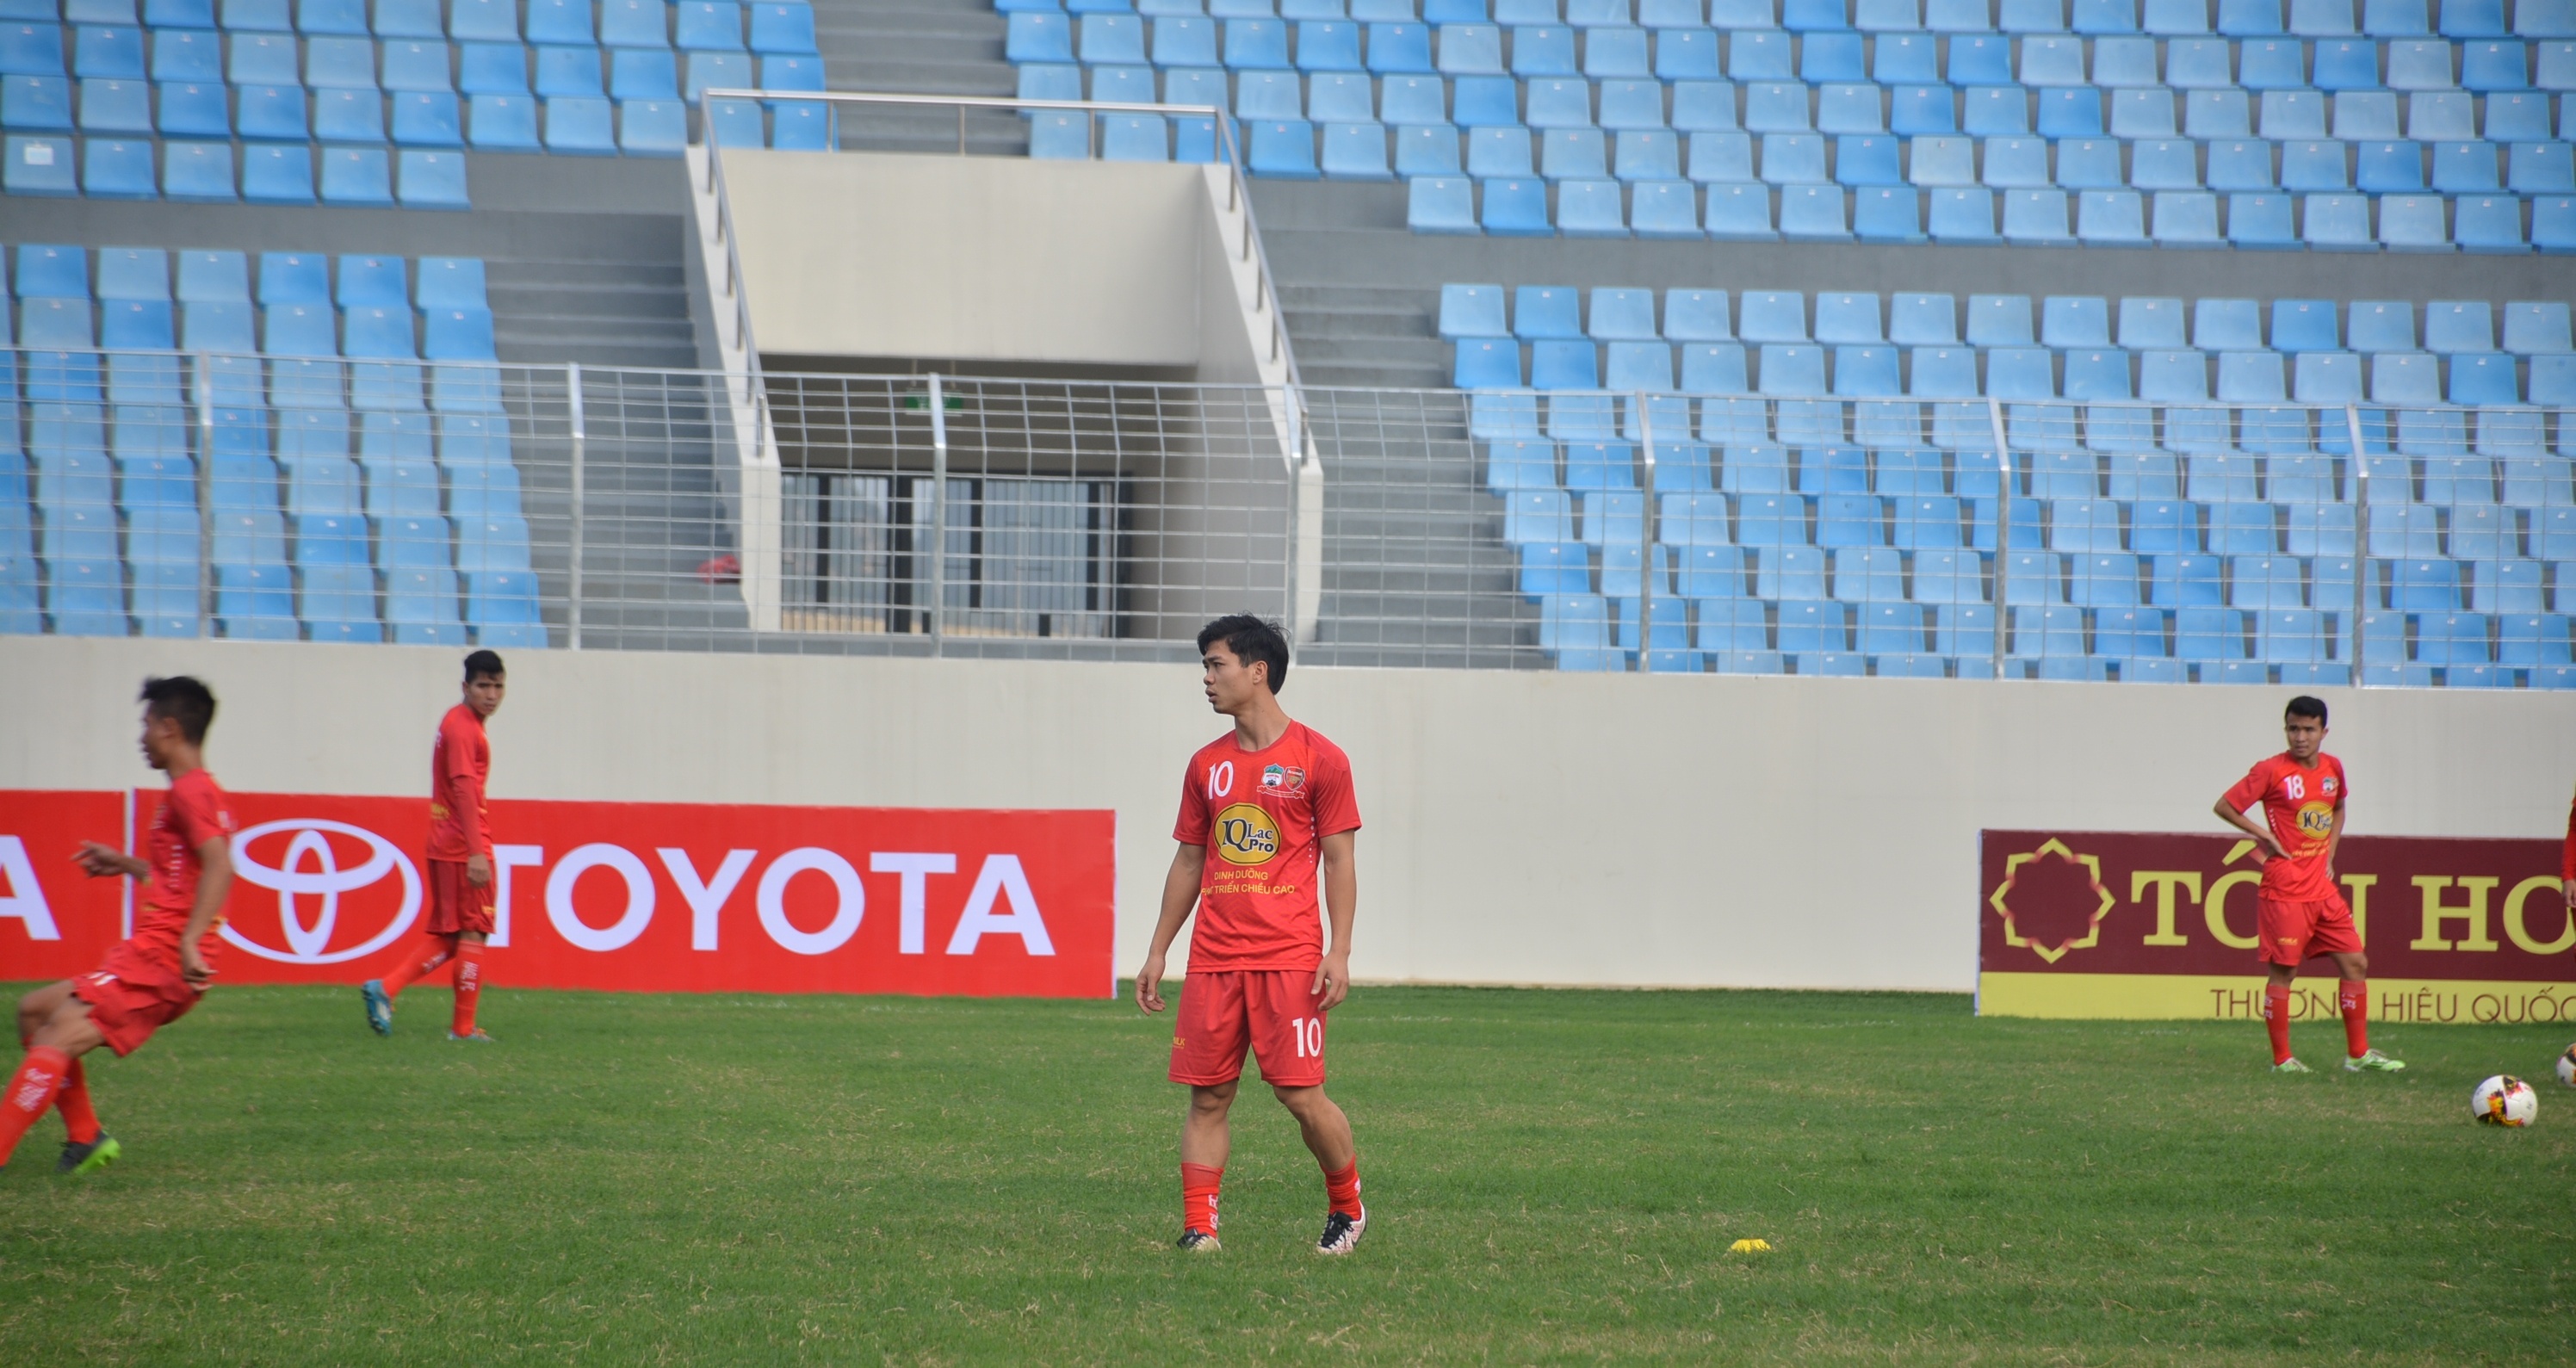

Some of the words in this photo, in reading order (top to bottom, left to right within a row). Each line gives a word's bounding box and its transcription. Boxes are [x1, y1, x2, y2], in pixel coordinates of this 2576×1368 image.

[1209, 760, 1234, 800] 10
[2283, 774, 2306, 800] 18
[1222, 819, 1249, 852] IQ
[1248, 824, 1273, 840] Lac
[1248, 839, 1274, 853] Pro
[486, 842, 1056, 956] TOYOTA
[1273, 885, 1295, 894] CAO
[1291, 1018, 1322, 1058] 10
